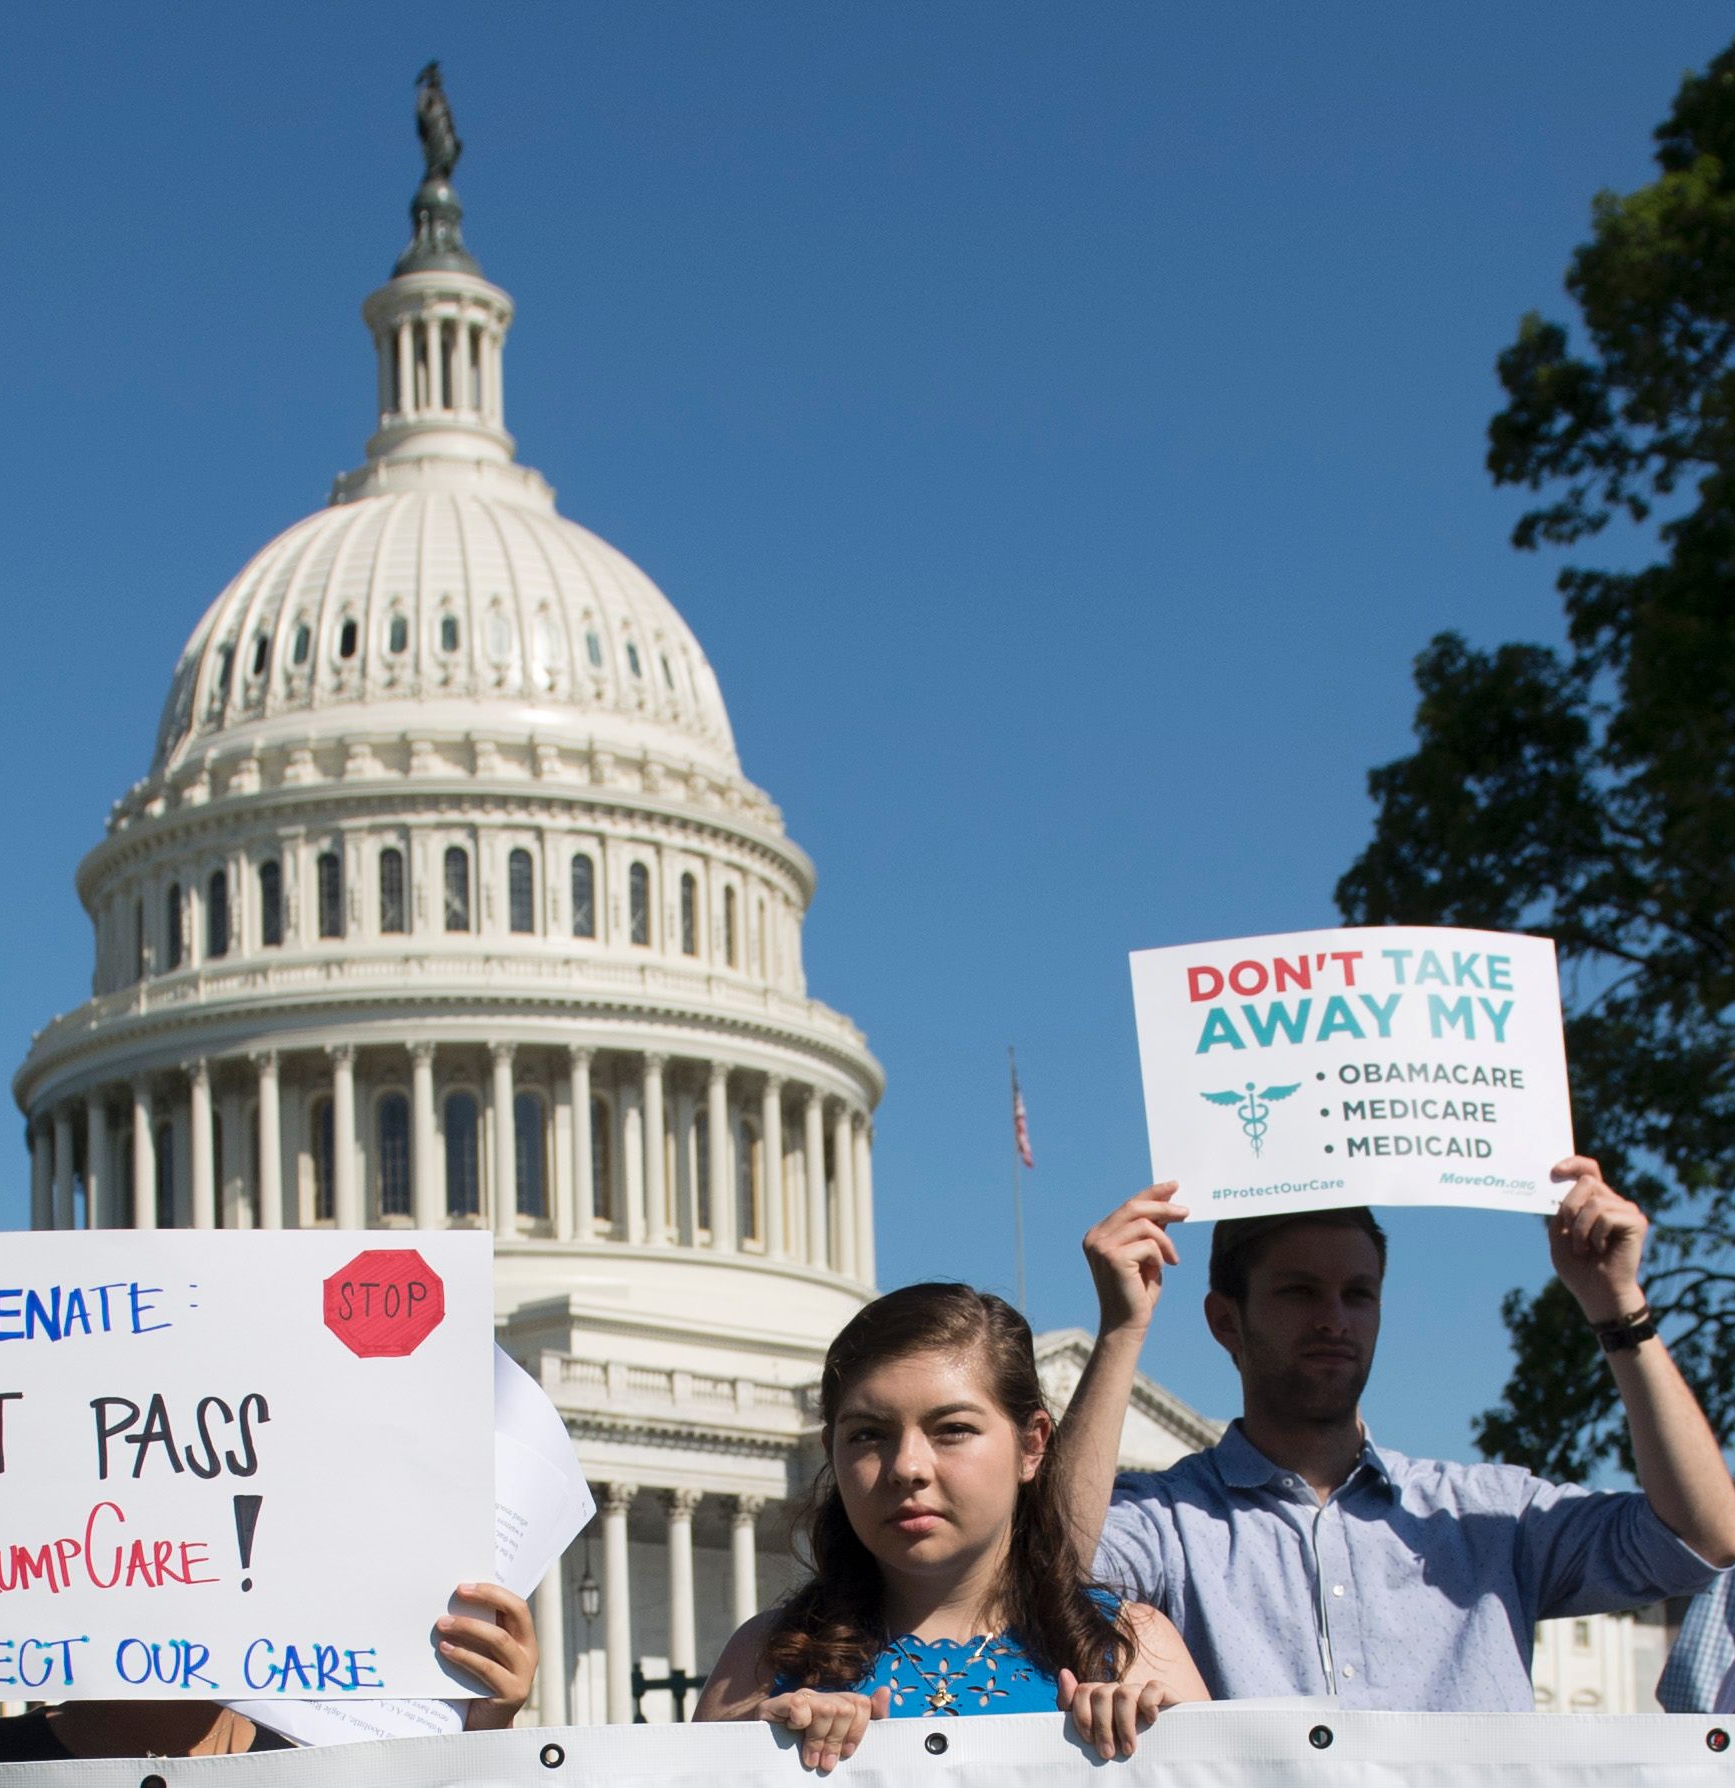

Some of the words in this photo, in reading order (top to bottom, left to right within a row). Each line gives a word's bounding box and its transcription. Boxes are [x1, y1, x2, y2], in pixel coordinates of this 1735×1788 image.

[1187, 951, 1363, 1002] DON'T
[1381, 949, 1514, 992] TAKE
[1195, 994, 1403, 1055] AWAY
[1427, 995, 1515, 1043] MY
[1338, 1063, 1525, 1089] OBAMACARE
[1343, 1100, 1497, 1123] MEDICARE
[1347, 1136, 1492, 1158] MEDICAID
[1212, 1178, 1344, 1200] #ProtectOurCare
[1439, 1173, 1536, 1191] MoveOn.ORG
[339, 1281, 427, 1321] STOP
[89, 1393, 271, 1480] PASS
[116, 1638, 220, 1693] OUR
[243, 1639, 384, 1694] CARE
